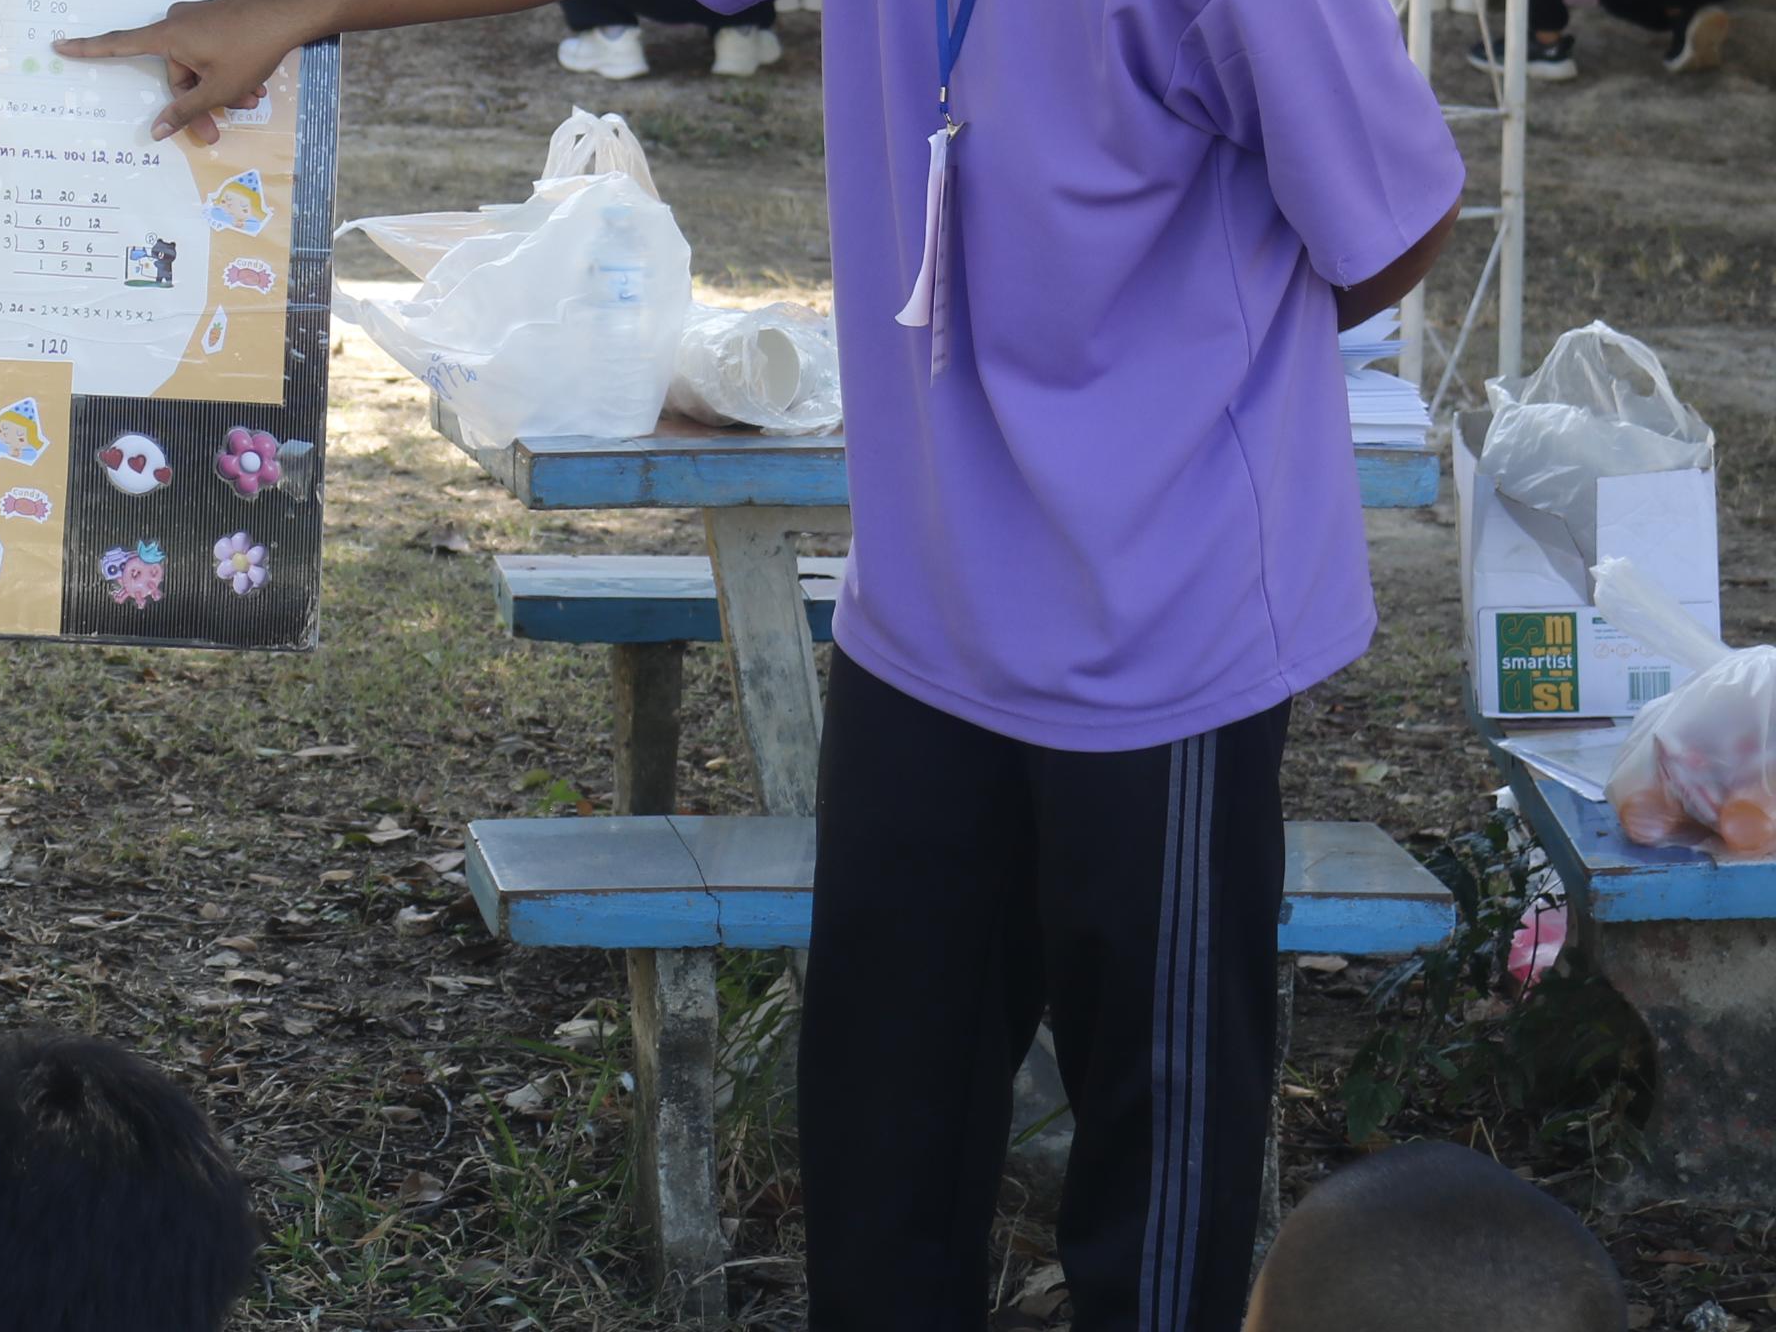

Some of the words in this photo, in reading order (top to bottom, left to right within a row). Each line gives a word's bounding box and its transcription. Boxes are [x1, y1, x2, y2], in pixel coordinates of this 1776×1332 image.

[27, 0, 41, 12] 12
[50, 1, 68, 14] 20
[64, 150, 86, 162] ของ
[142, 153, 160, 166] 24
[3, 190, 12, 200] 2
[30, 189, 43, 200] 12
[58, 191, 75, 202] 20
[91, 193, 108, 204] 24
[4, 214, 12, 224] 2
[35, 214, 42, 226] 6
[58, 216, 72, 227] 10
[88, 218, 101, 229] 12
[3, 237, 12, 249] 3
[37, 238, 45, 250] 3
[62, 241, 70, 252] 5
[86, 242, 93, 254] 6
[61, 260, 68, 271] 5
[84, 262, 94, 273] 2
[9, 303, 24, 313] 24
[40, 339, 68, 355] 120
[1502, 653, 1573, 670] smartist
